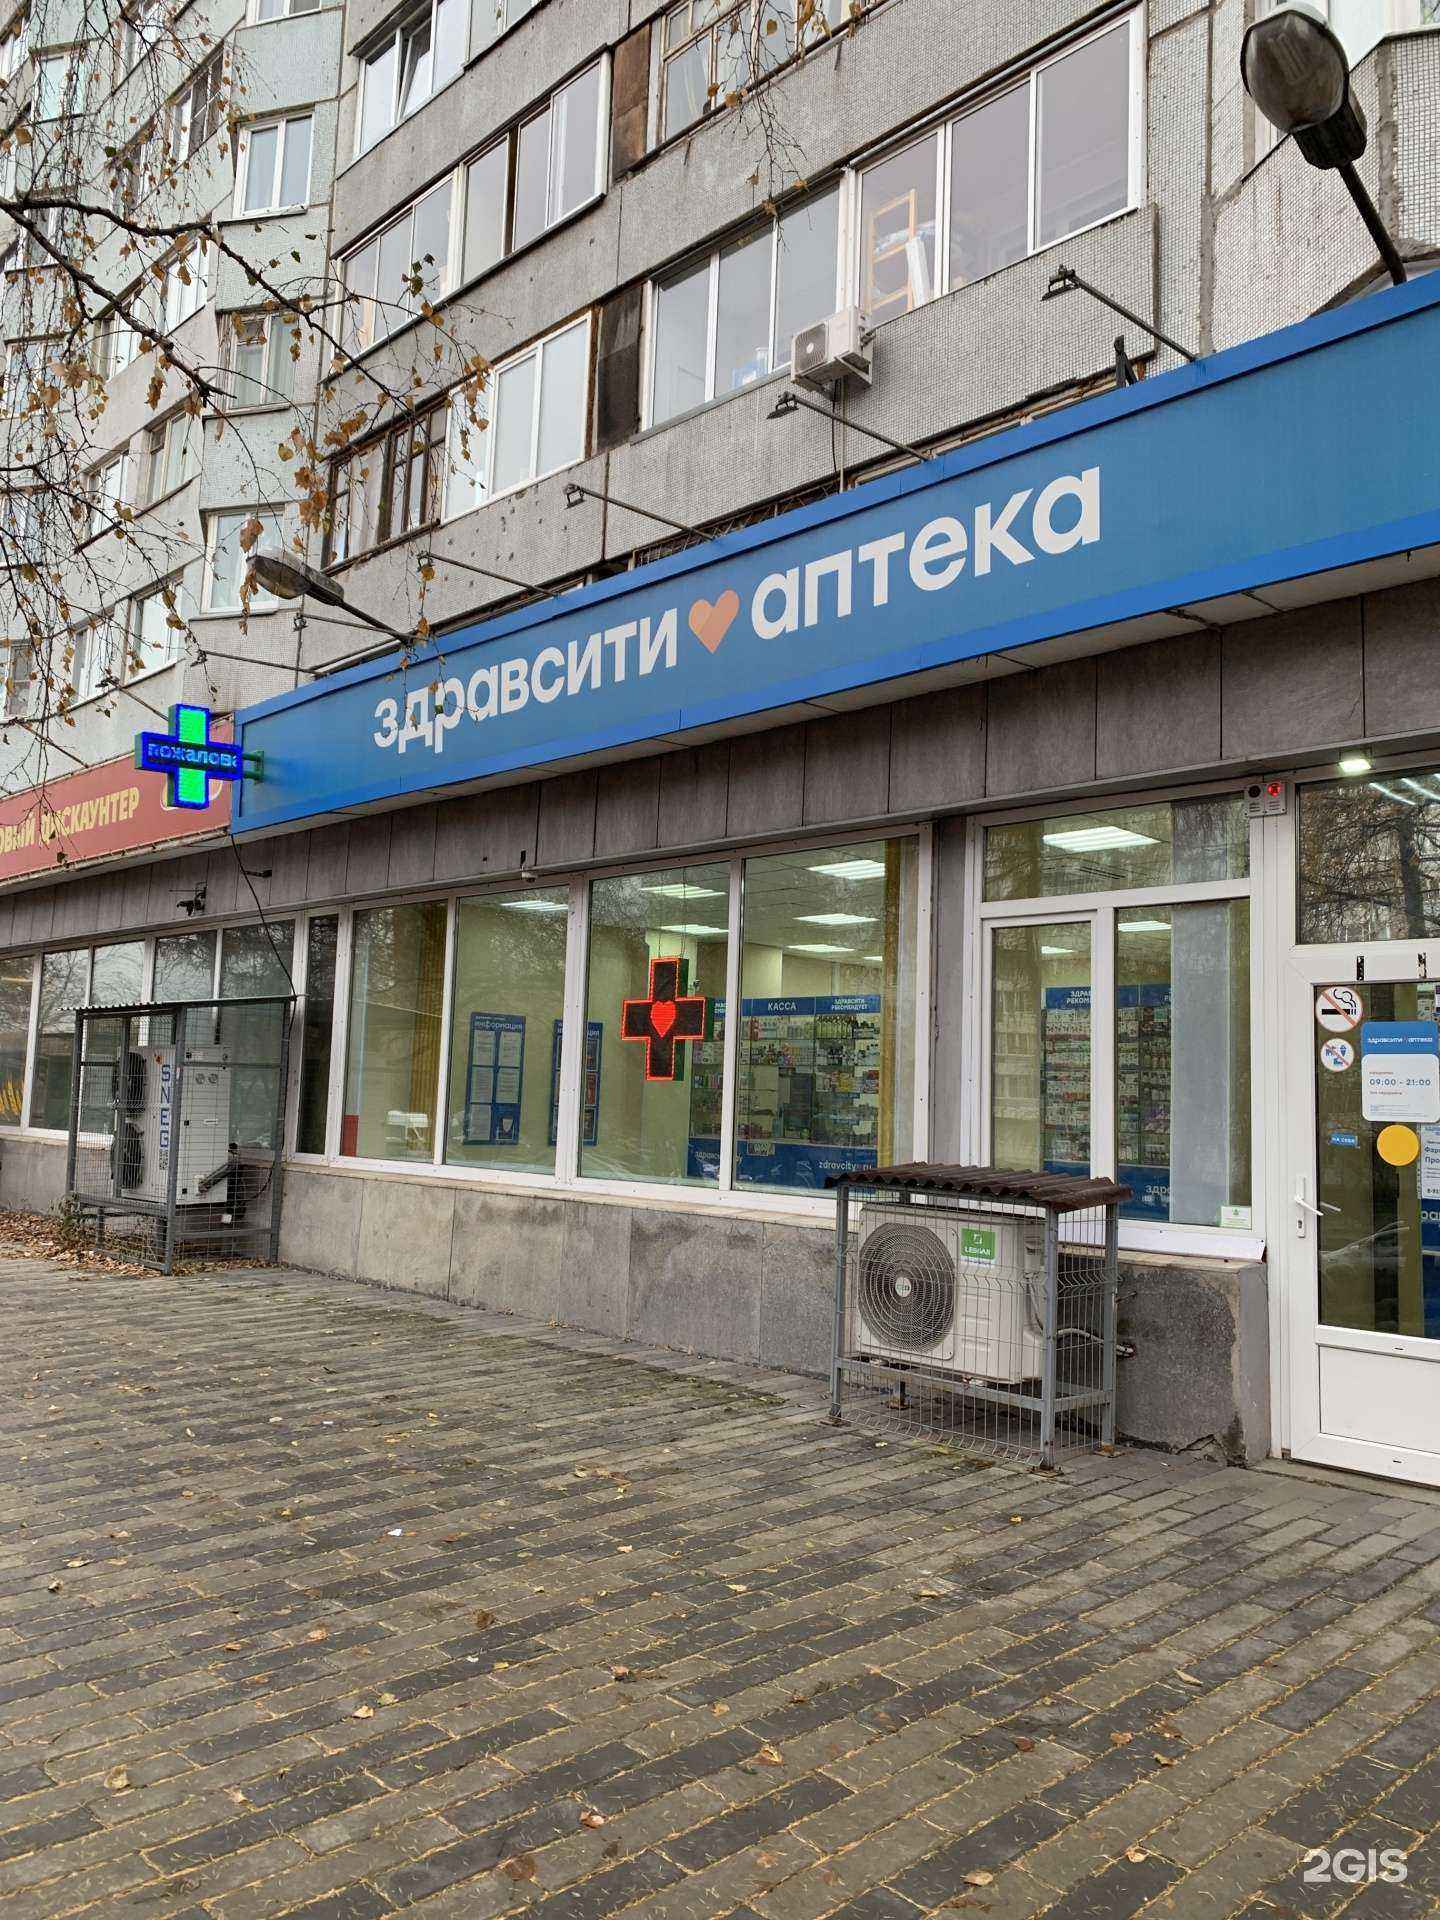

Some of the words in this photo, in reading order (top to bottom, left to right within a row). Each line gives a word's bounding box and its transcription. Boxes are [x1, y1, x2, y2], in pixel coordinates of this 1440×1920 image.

[373, 607, 678, 754] здравсити
[751, 465, 1101, 640] аптека
[767, 1001, 797, 1011] КАССА
[1369, 1078, 1397, 1087] 09:00
[1406, 1078, 1432, 1087] 21:00
